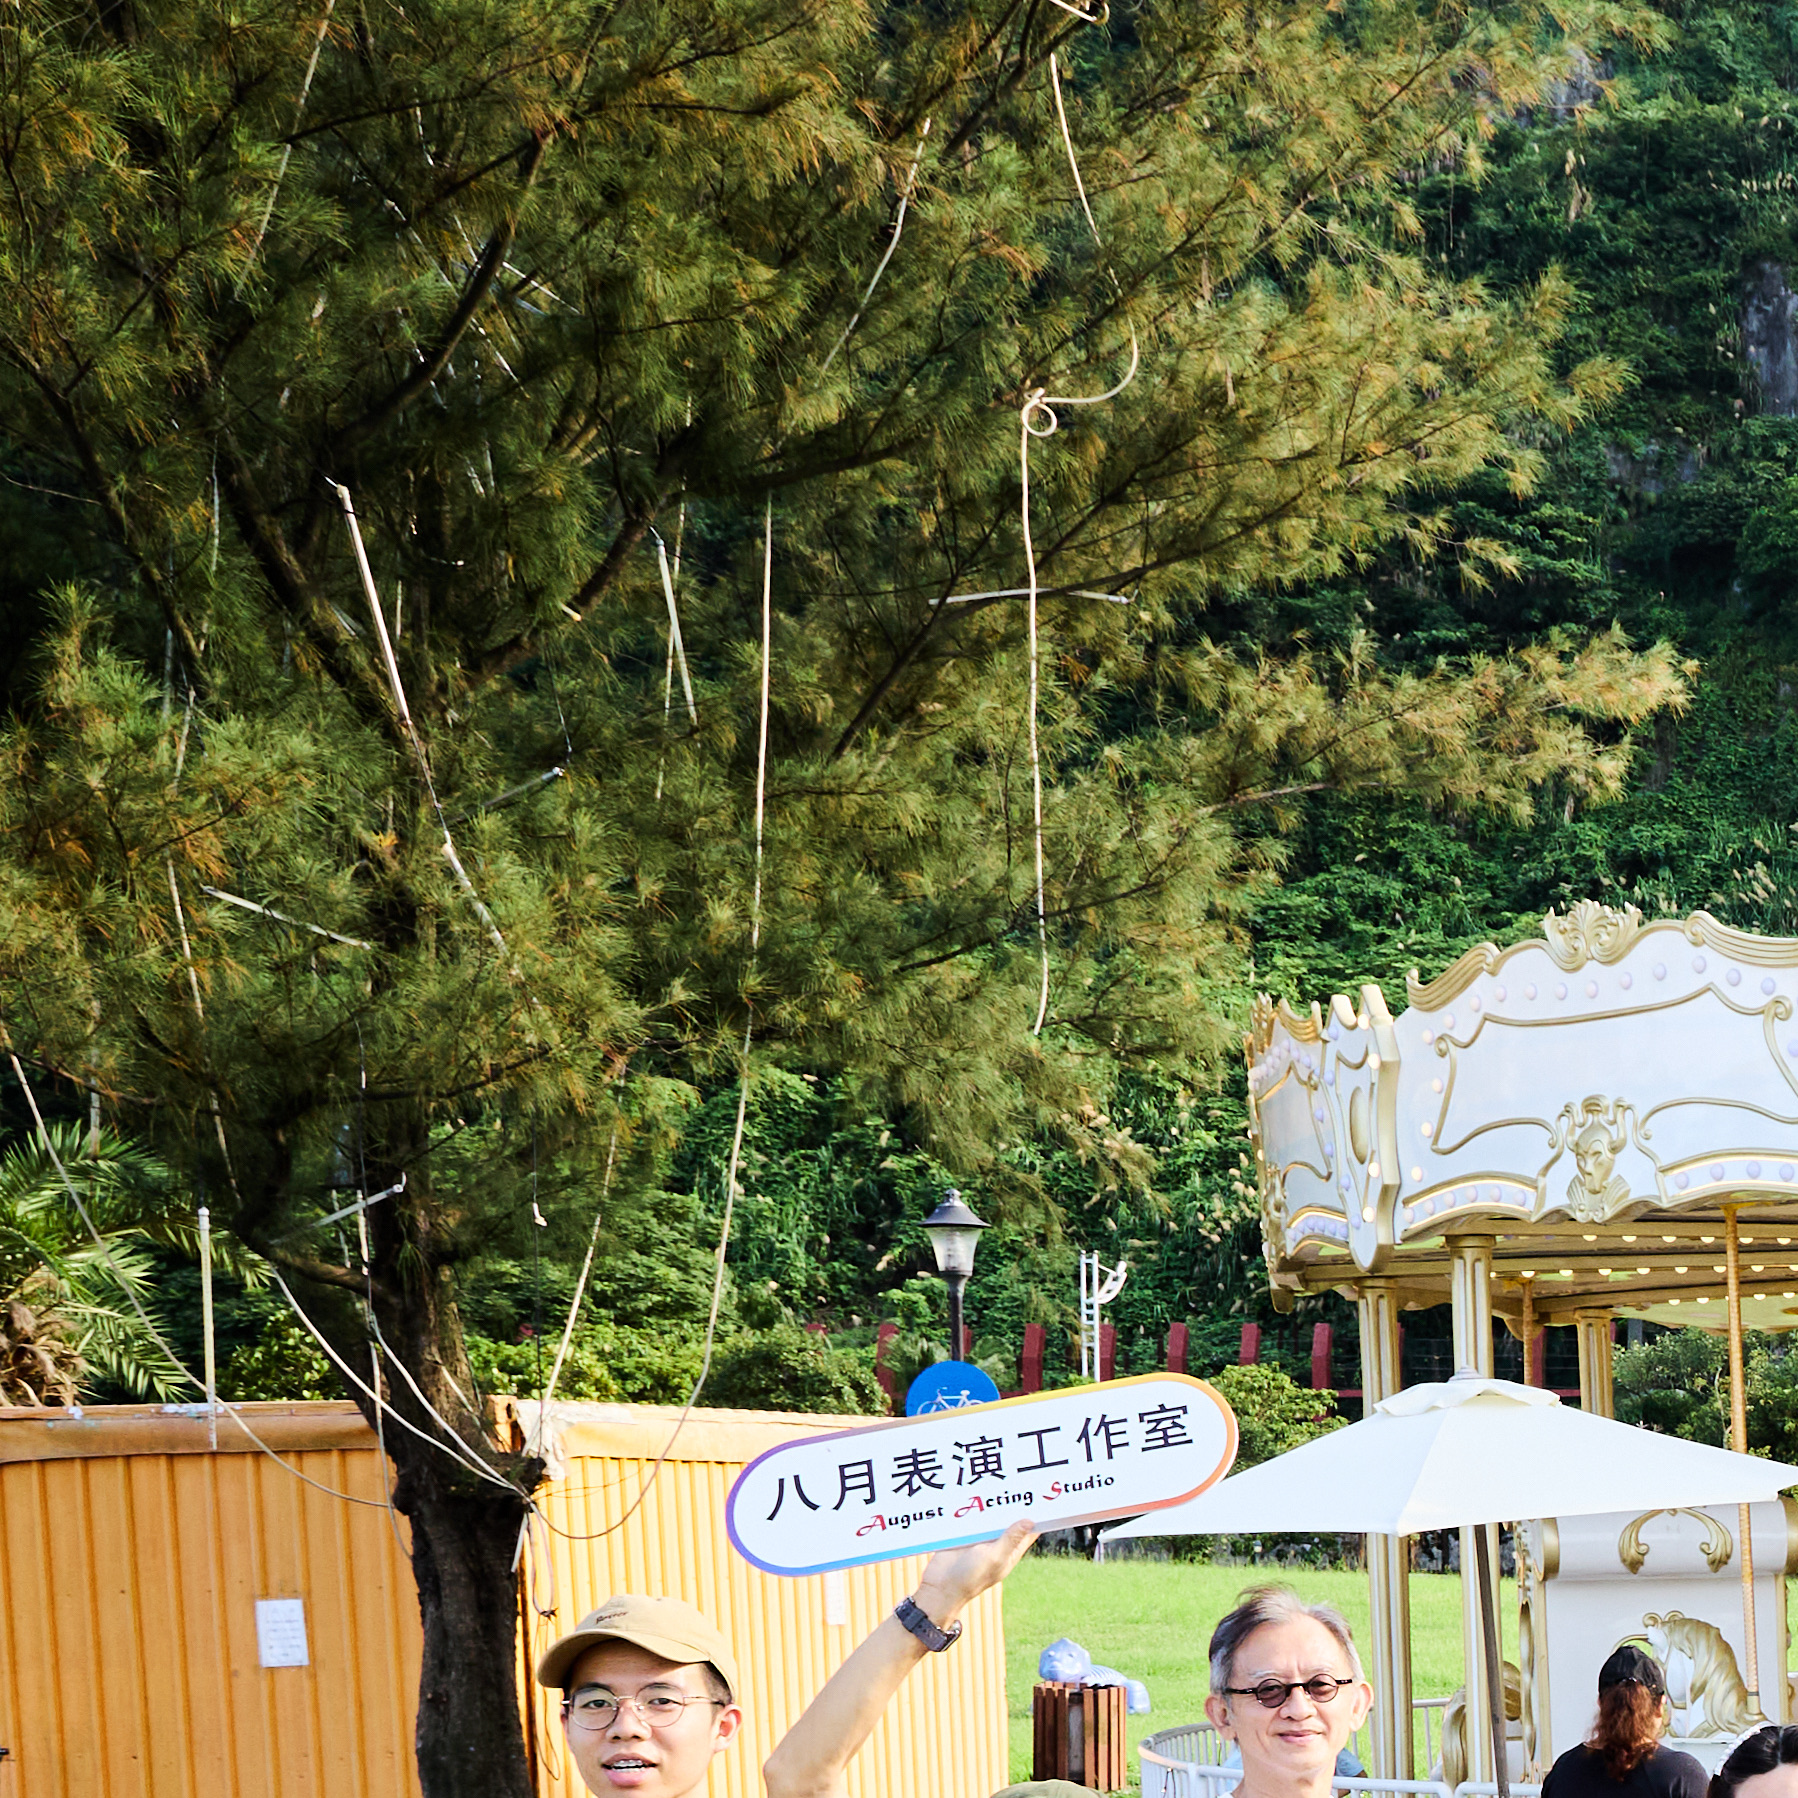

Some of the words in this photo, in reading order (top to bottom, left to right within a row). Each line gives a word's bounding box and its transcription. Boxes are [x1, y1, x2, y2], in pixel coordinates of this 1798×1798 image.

[766, 1403, 1194, 1521] 八月表演工作室
[856, 1504, 945, 1537] August
[953, 1488, 1035, 1518] Acting
[1042, 1472, 1116, 1501] Studio
